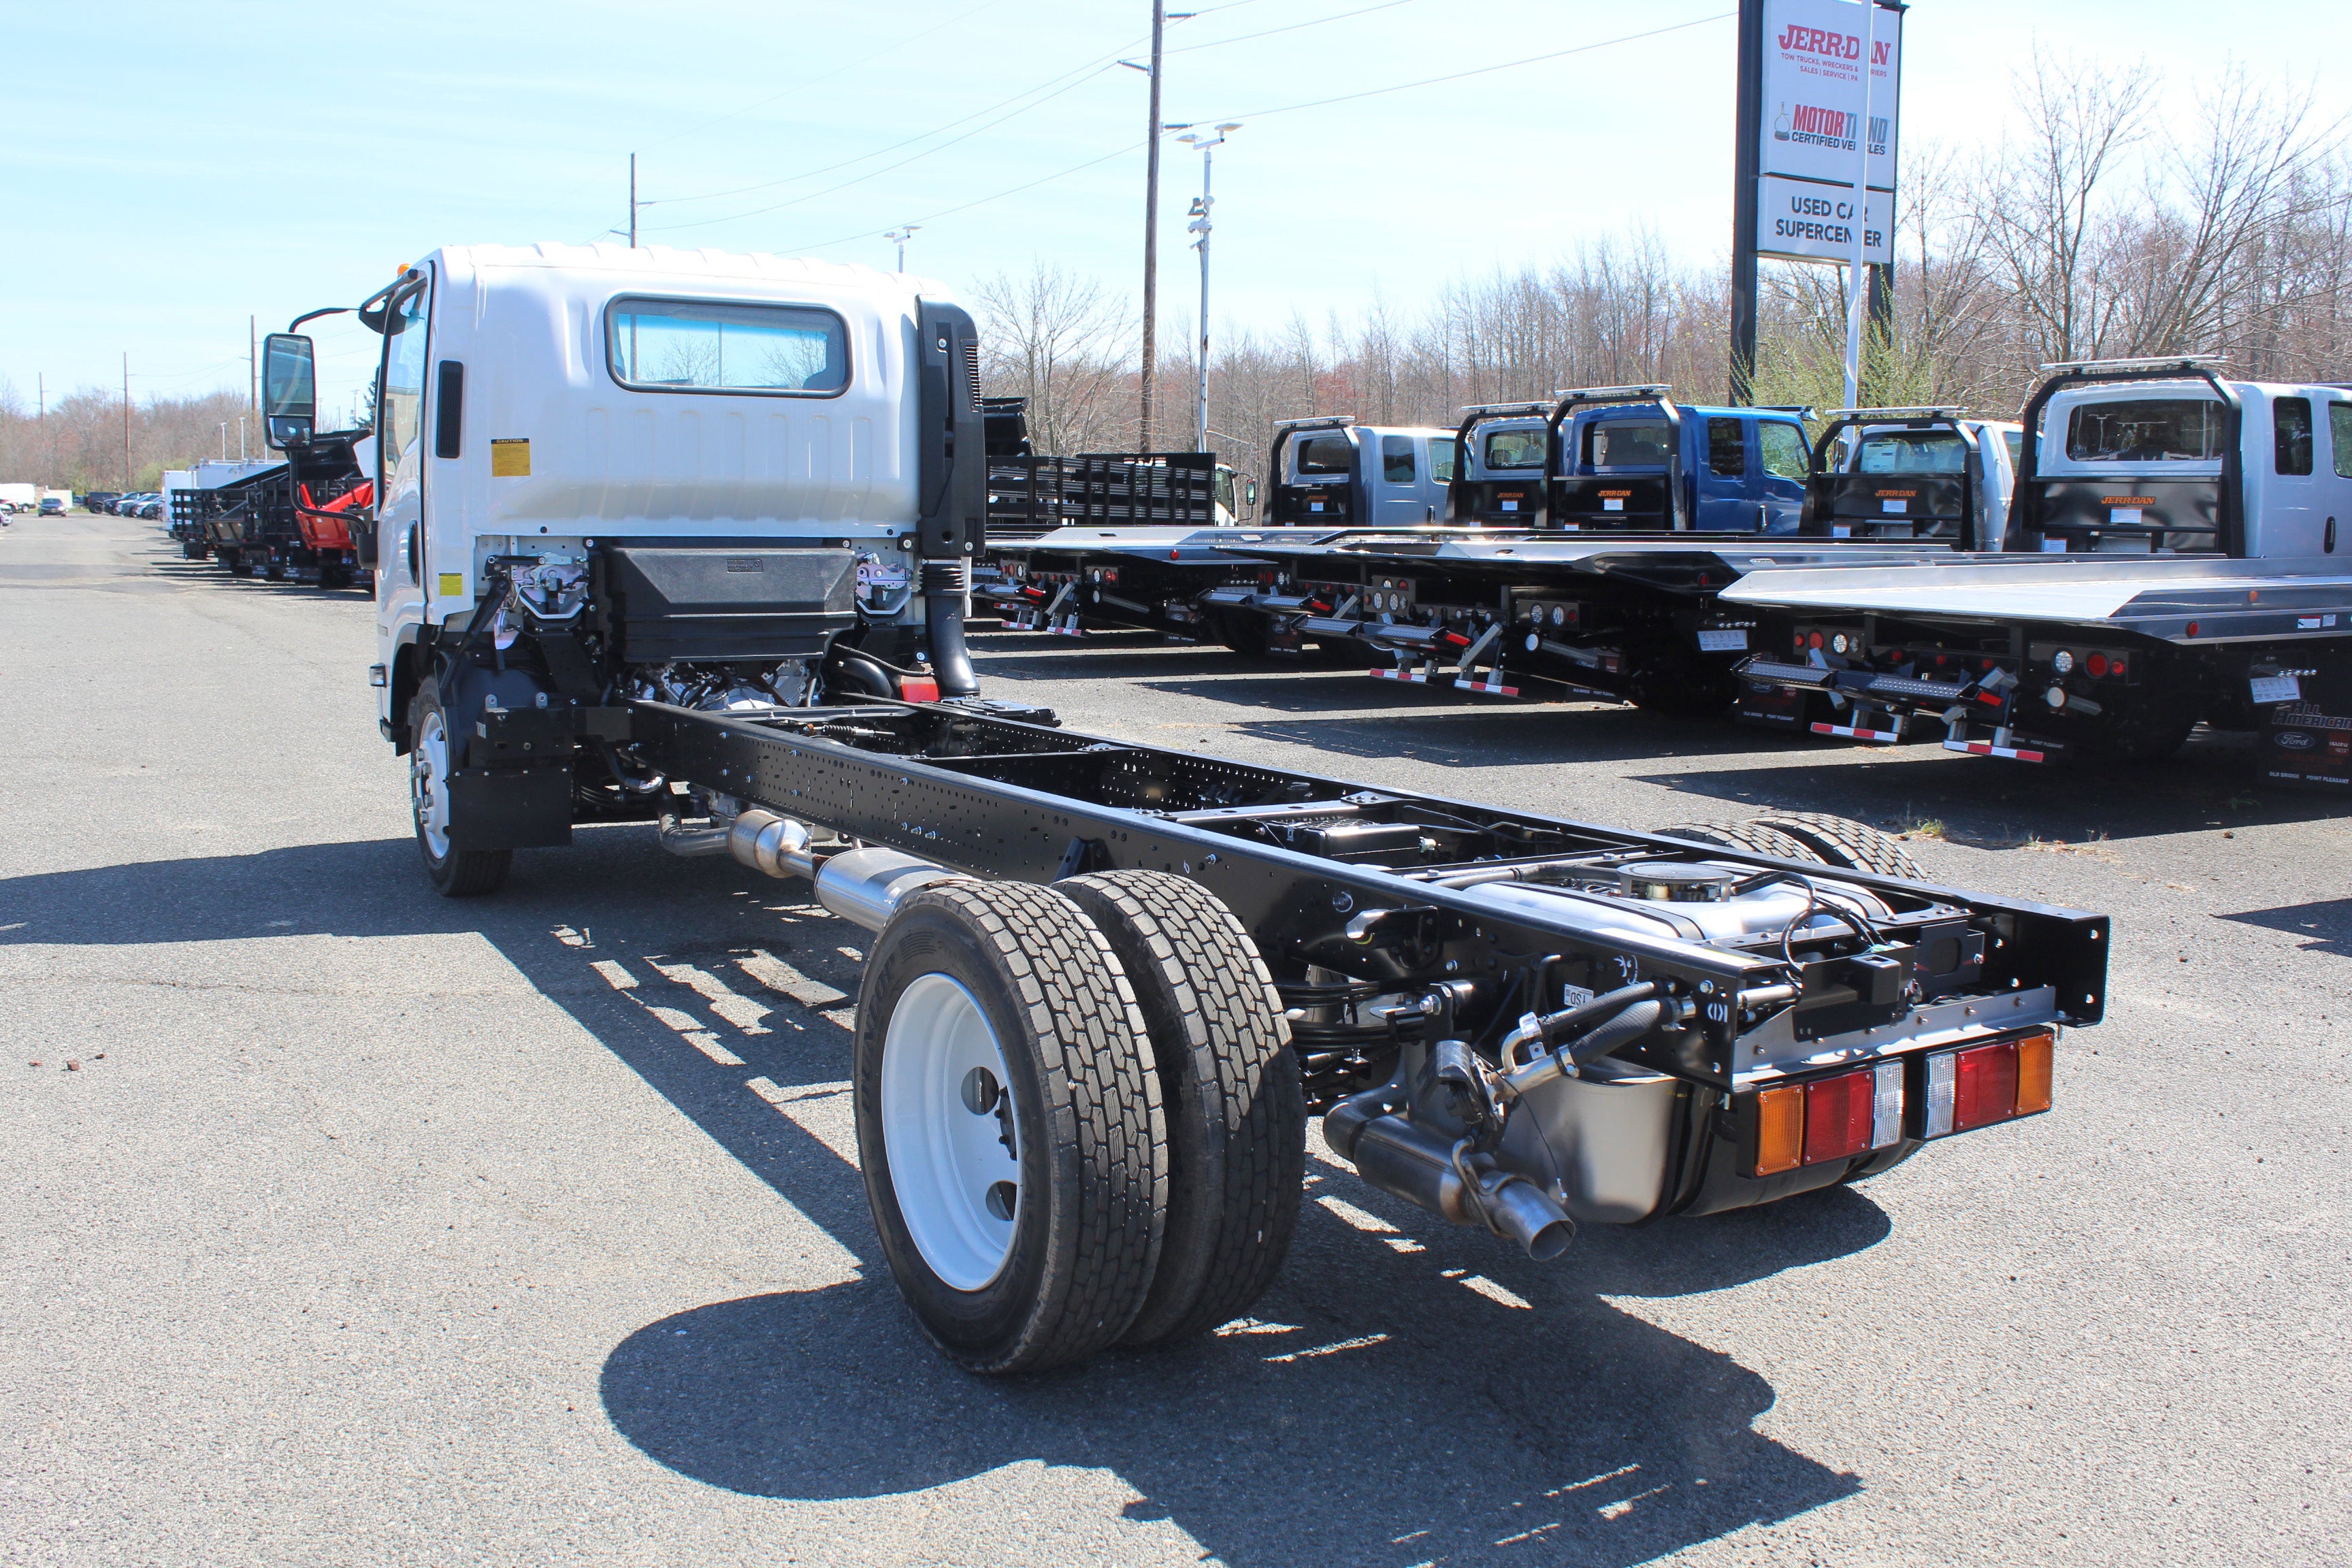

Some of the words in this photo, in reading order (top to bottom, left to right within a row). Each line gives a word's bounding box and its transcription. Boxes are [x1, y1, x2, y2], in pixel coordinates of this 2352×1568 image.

[1778, 24, 1891, 66] JERR-DN
[1781, 52, 1795, 61] TOW
[1797, 56, 1820, 66] TRUCKS,
[1822, 60, 1853, 71] WRECKERS
[1799, 66, 1818, 74] SALES
[1823, 70, 1846, 80] SERVICE
[1793, 104, 1888, 144] MOTORTND
[1791, 131, 1840, 148] CERTIFIED
[1842, 140, 1885, 155] VELES
[1791, 196, 1831, 217] USED
[1776, 218, 1881, 248] SUPERCENER
[2281, 734, 2309, 746] Ford
